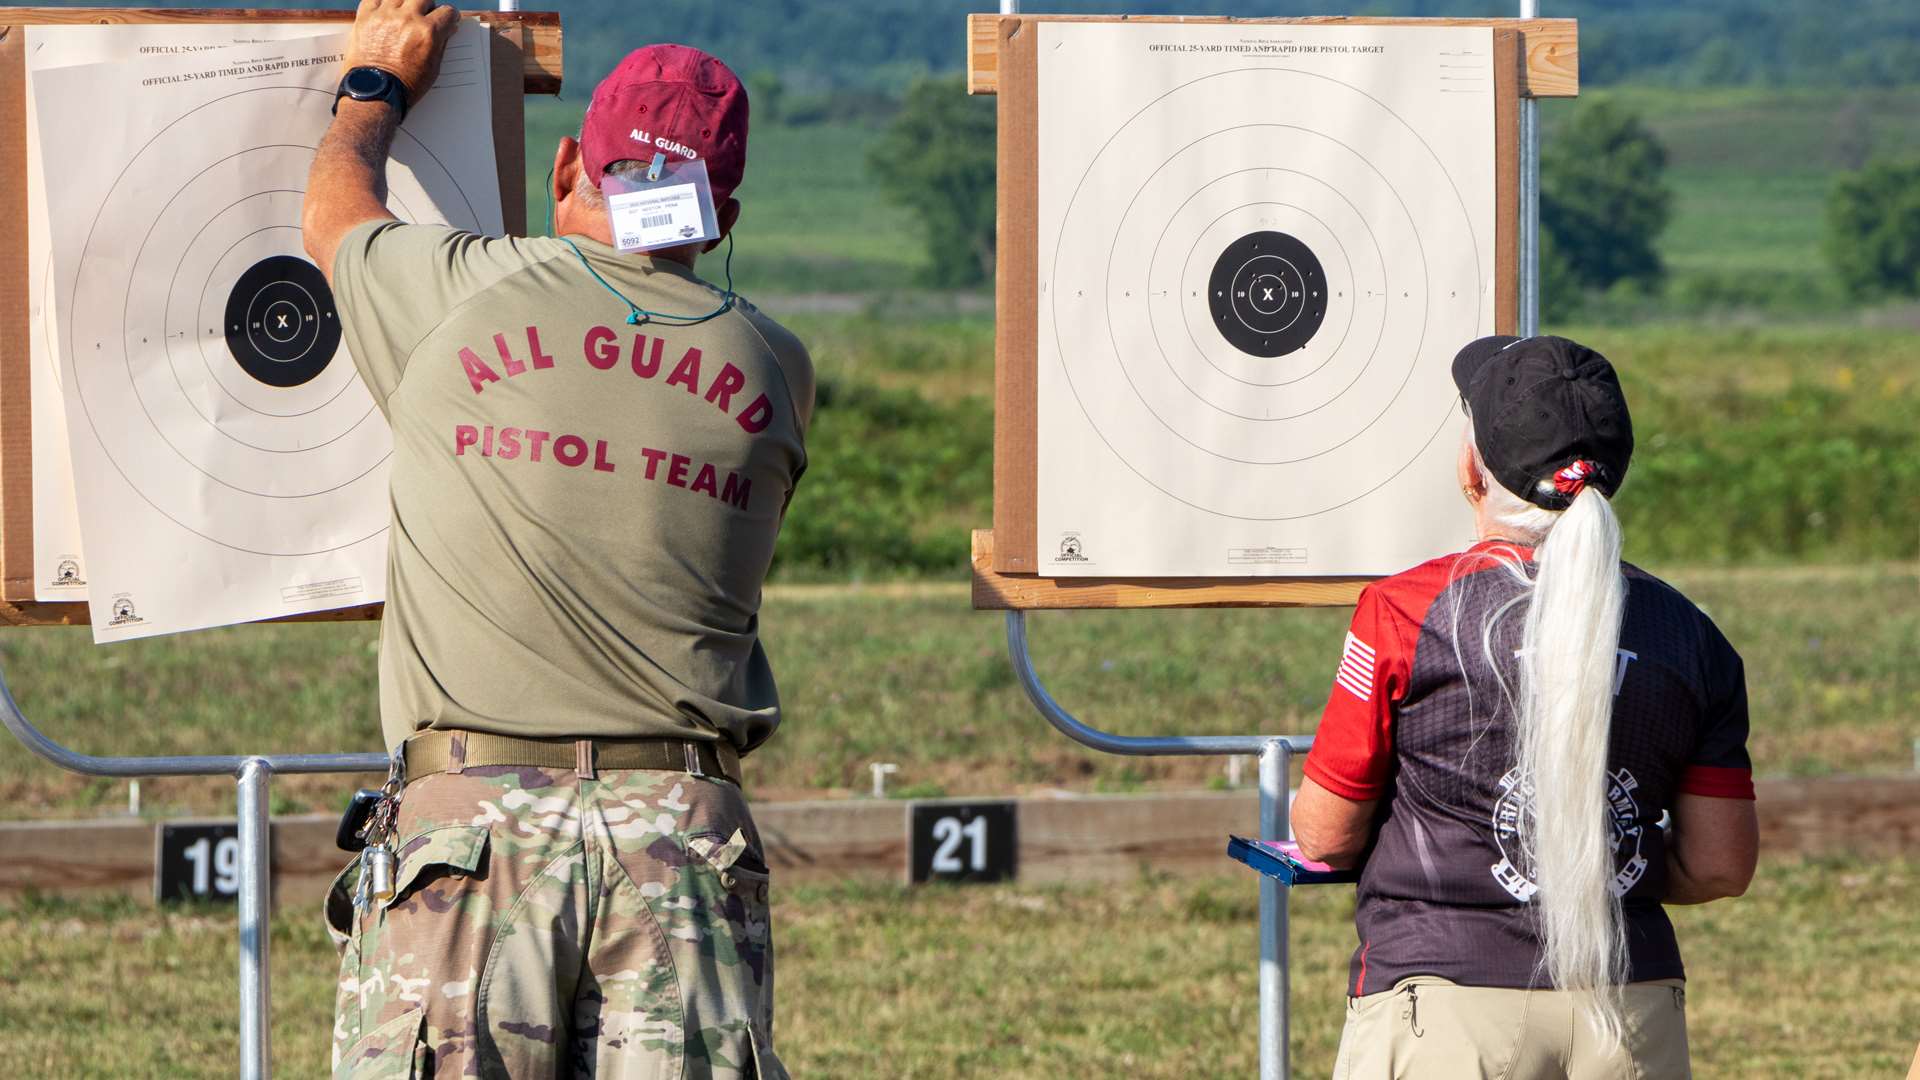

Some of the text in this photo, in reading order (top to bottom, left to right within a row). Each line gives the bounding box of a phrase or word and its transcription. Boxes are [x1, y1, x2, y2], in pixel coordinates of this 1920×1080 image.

[140, 46, 180, 54] OFFICIAL
[1149, 44, 1187, 52] OFFICIAL
[1188, 44, 1222, 52] 25-YARD
[1224, 45, 1251, 53] TIMED
[1271, 45, 1298, 53] RAPID
[1299, 45, 1318, 53] FIRE
[1320, 45, 1348, 53] PISTOL
[1351, 45, 1384, 53] TARGET
[142, 75, 181, 86] OFFICIAL
[183, 71, 216, 81] 25-YARD
[218, 67, 245, 77] TIMED
[247, 64, 263, 73] AND
[265, 61, 290, 71] RAPID
[291, 58, 309, 68] FIRE
[311, 54, 338, 65] PISTOL
[629, 128, 698, 160] ALL GUARD
[1263, 288, 1274, 301] X
[277, 314, 289, 329] X
[305, 314, 313, 322] 10
[457, 325, 774, 434] ALL GUARD
[455, 425, 752, 511] PISTOL TEAM
[932, 815, 987, 872] 21
[183, 836, 239, 895] 19
